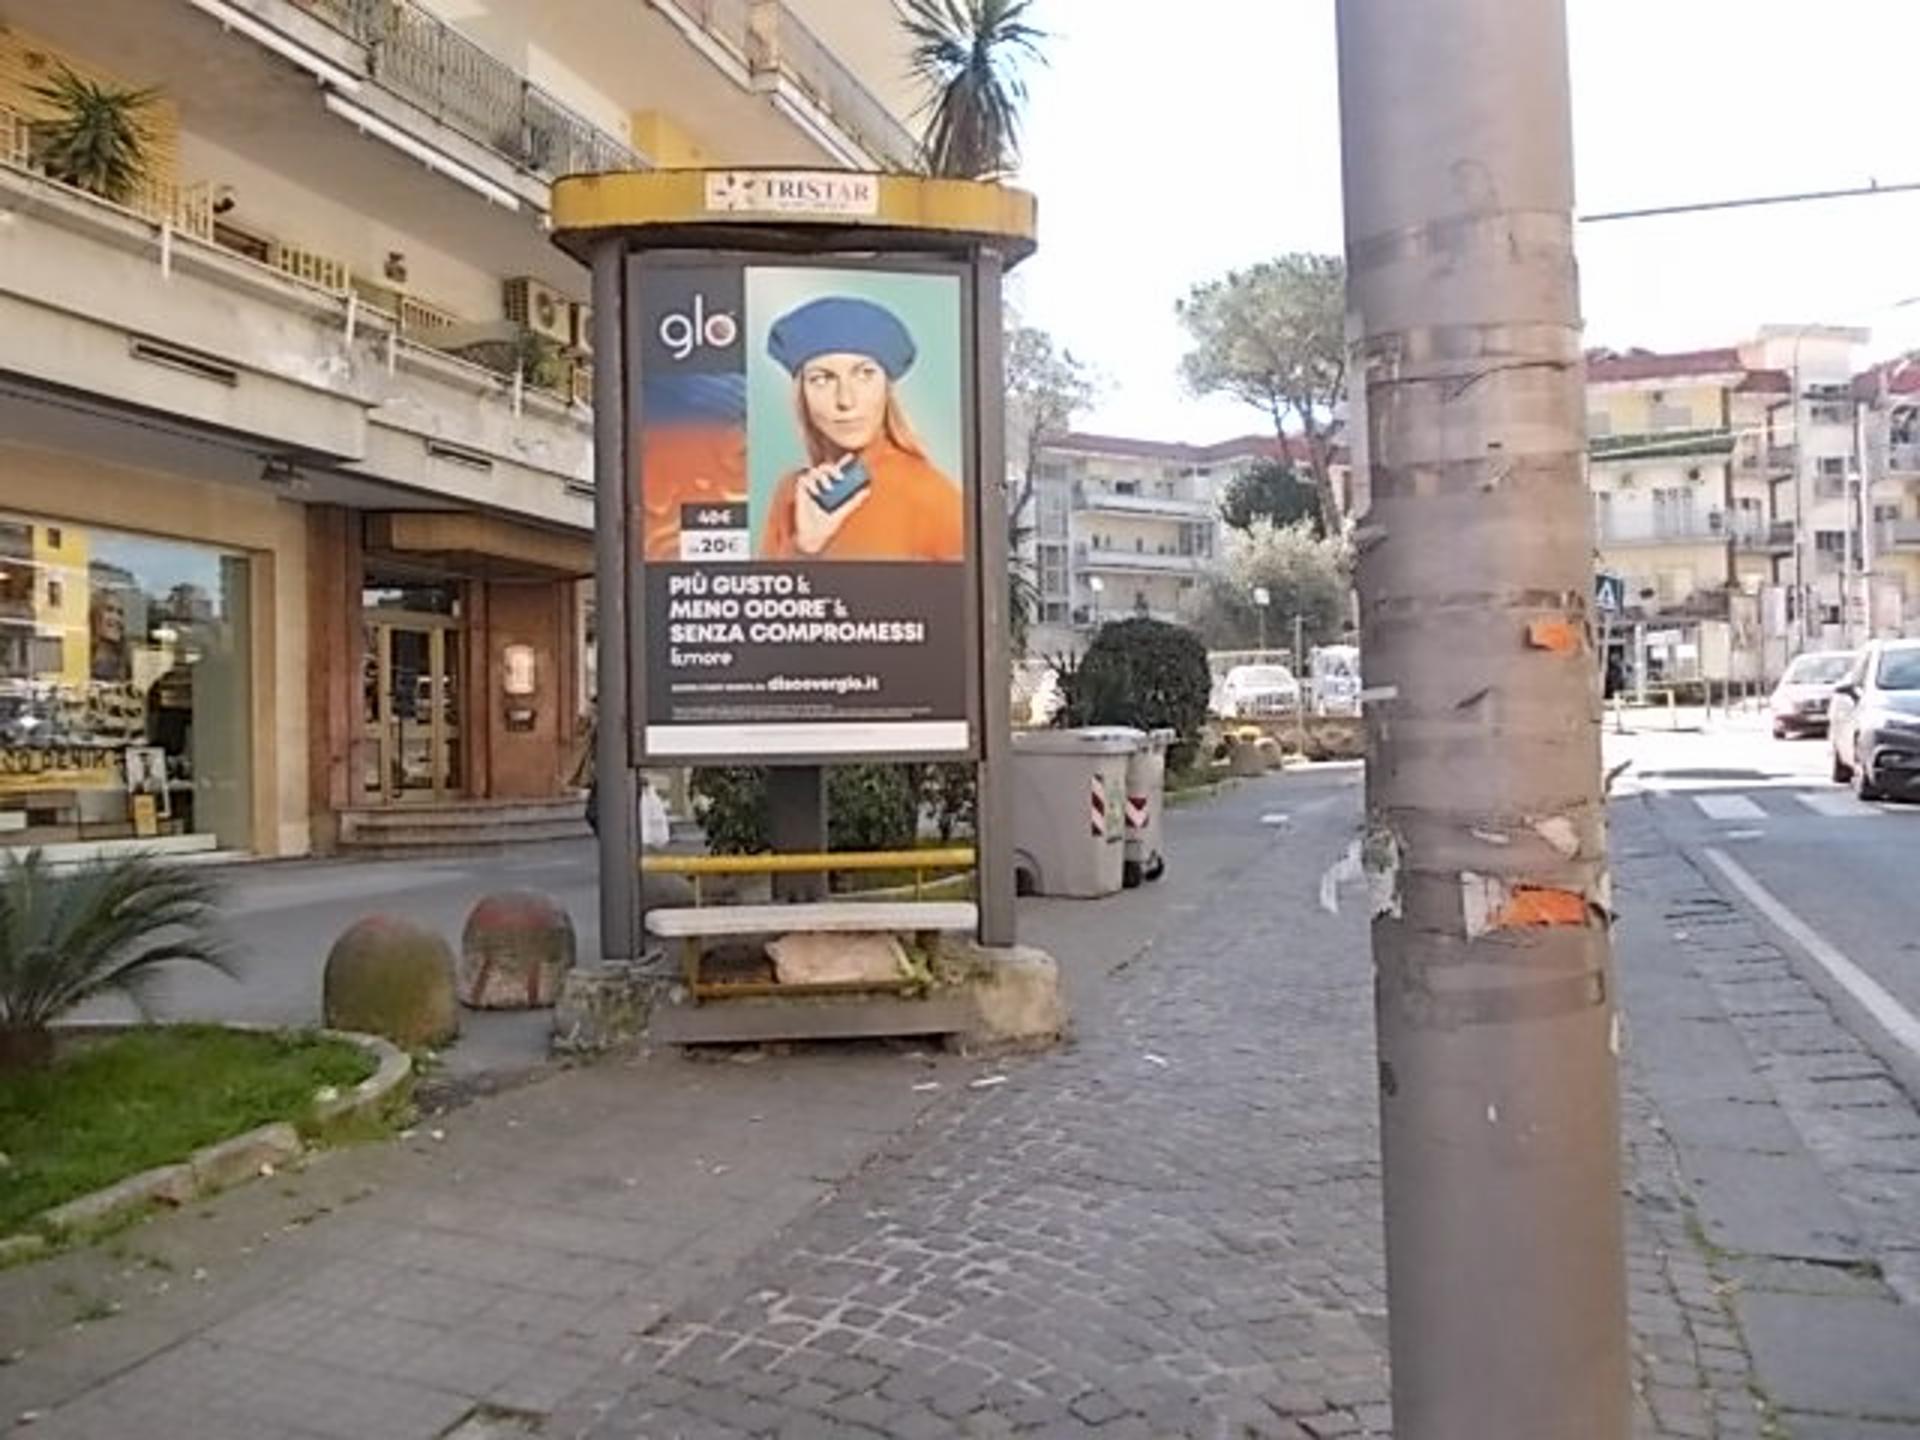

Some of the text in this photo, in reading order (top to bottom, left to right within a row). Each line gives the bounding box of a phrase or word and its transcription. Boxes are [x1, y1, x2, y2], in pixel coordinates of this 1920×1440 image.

[764, 179, 869, 200] TRISTAR
[660, 293, 737, 360] glo
[669, 571, 707, 595] PIÙ
[712, 575, 793, 595] GUSTO
[669, 599, 740, 618] MENO
[669, 622, 925, 642] SENZA COMPROMESSI
